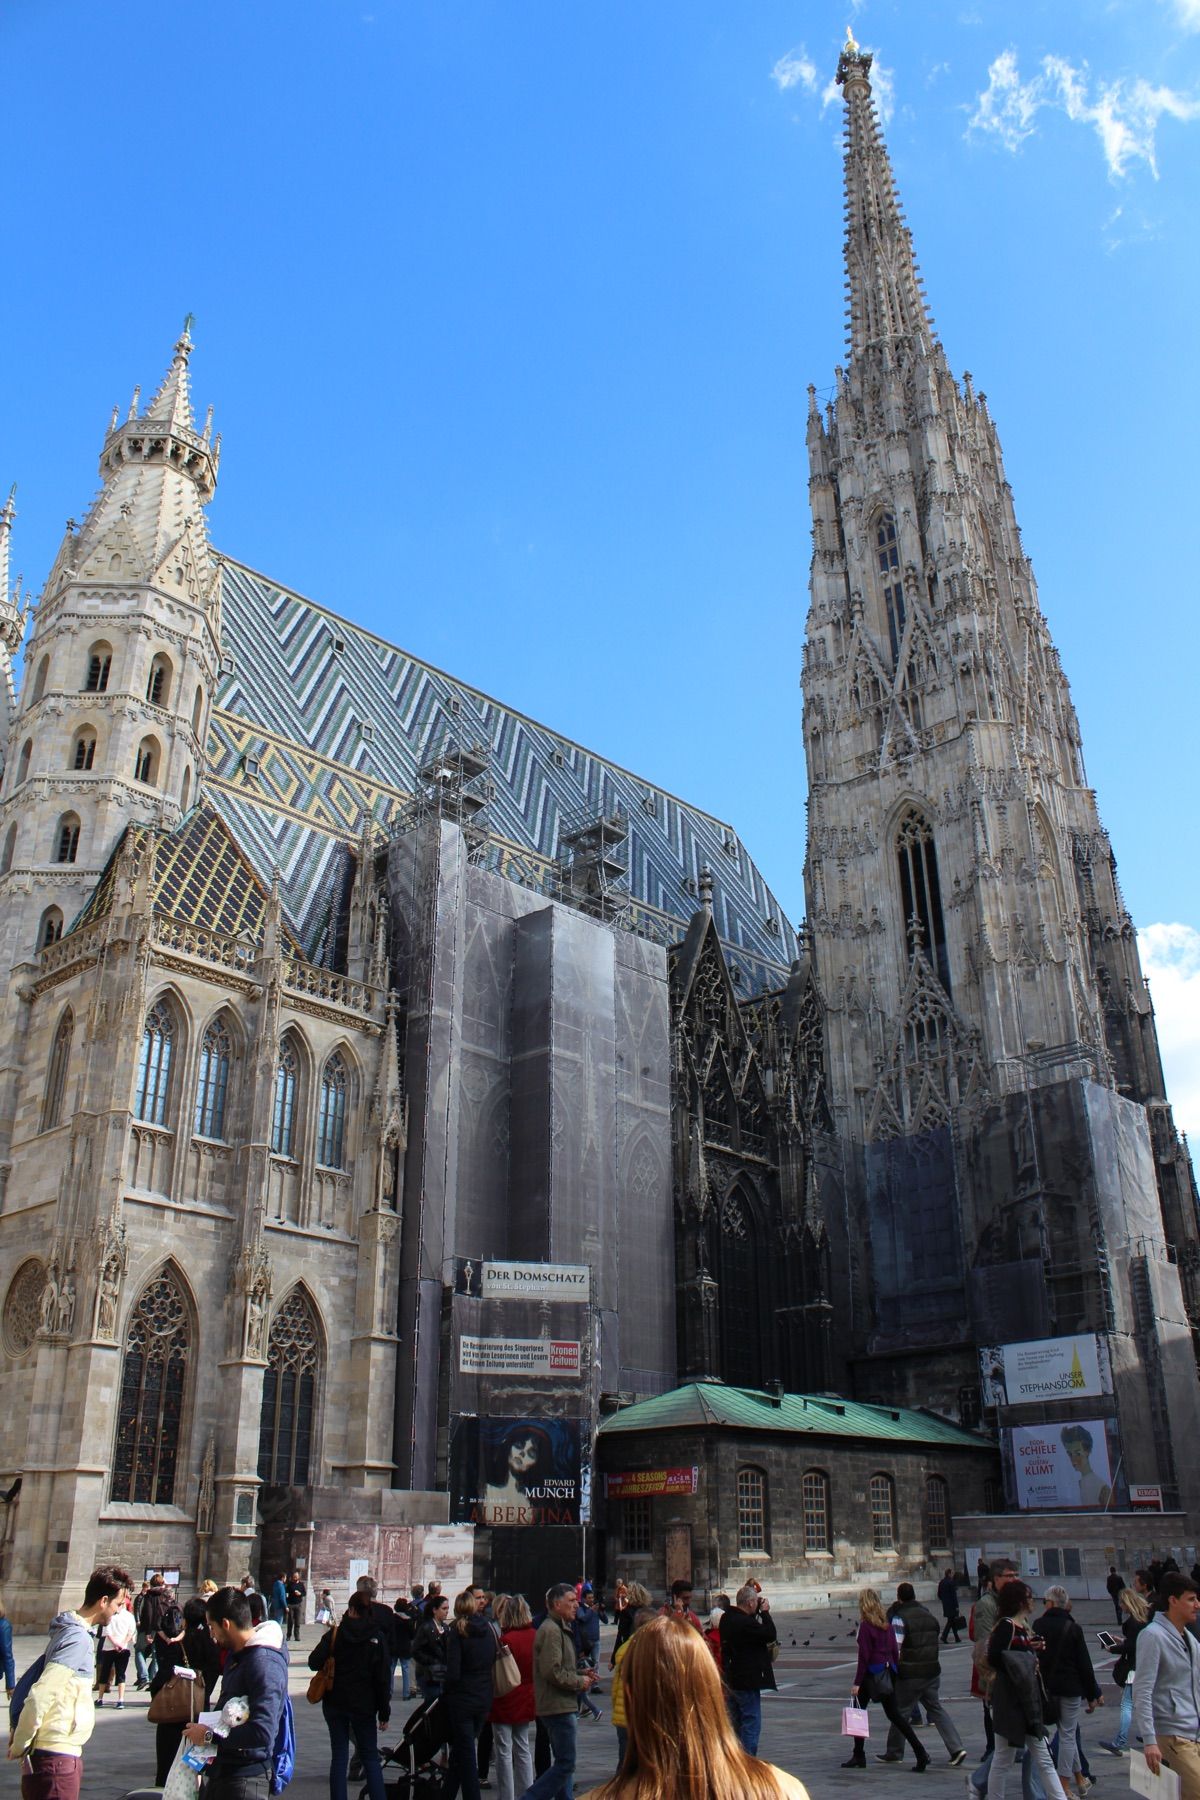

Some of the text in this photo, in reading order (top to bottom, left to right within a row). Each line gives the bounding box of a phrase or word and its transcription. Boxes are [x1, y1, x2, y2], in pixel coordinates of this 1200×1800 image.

[487, 1269, 585, 1284] DER DOMSCHATZ
[551, 1344, 578, 1356] Kronen
[550, 1355, 578, 1367] Zeitung
[1059, 1371, 1082, 1380] UNSER
[1019, 1379, 1086, 1394] STEPHANSDOM
[1019, 1444, 1057, 1456] SCHIELE
[1024, 1464, 1054, 1475] KLIMT
[637, 1471, 667, 1482] SEASONS
[544, 1479, 575, 1487] EDVARD
[524, 1487, 575, 1499] MUNCH
[470, 1506, 573, 1524] ALBERTINA
